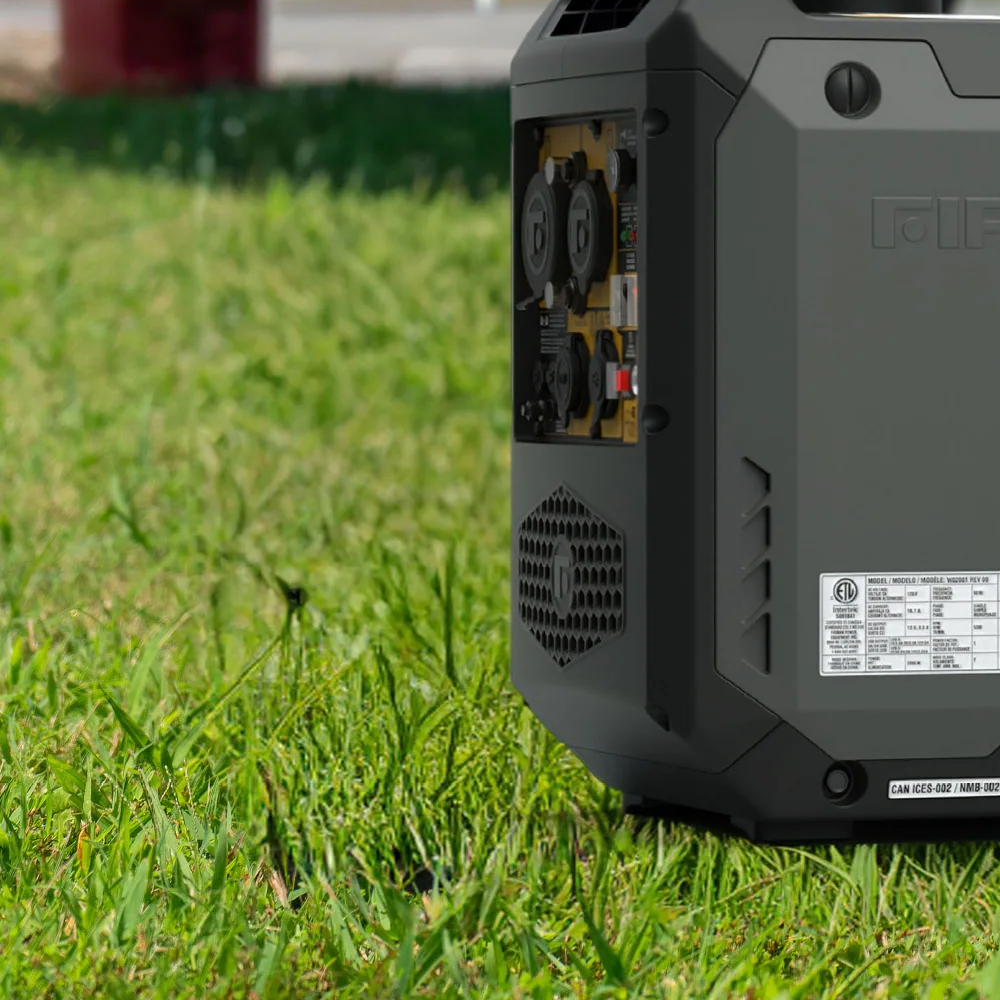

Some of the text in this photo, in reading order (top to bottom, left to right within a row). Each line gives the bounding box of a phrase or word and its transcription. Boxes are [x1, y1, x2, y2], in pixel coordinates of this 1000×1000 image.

[832, 605, 858, 613] Intertek
[891, 784, 910, 794] CAN
[912, 783, 952, 793] ICES-002
[959, 782, 1000, 792] NMB-002
